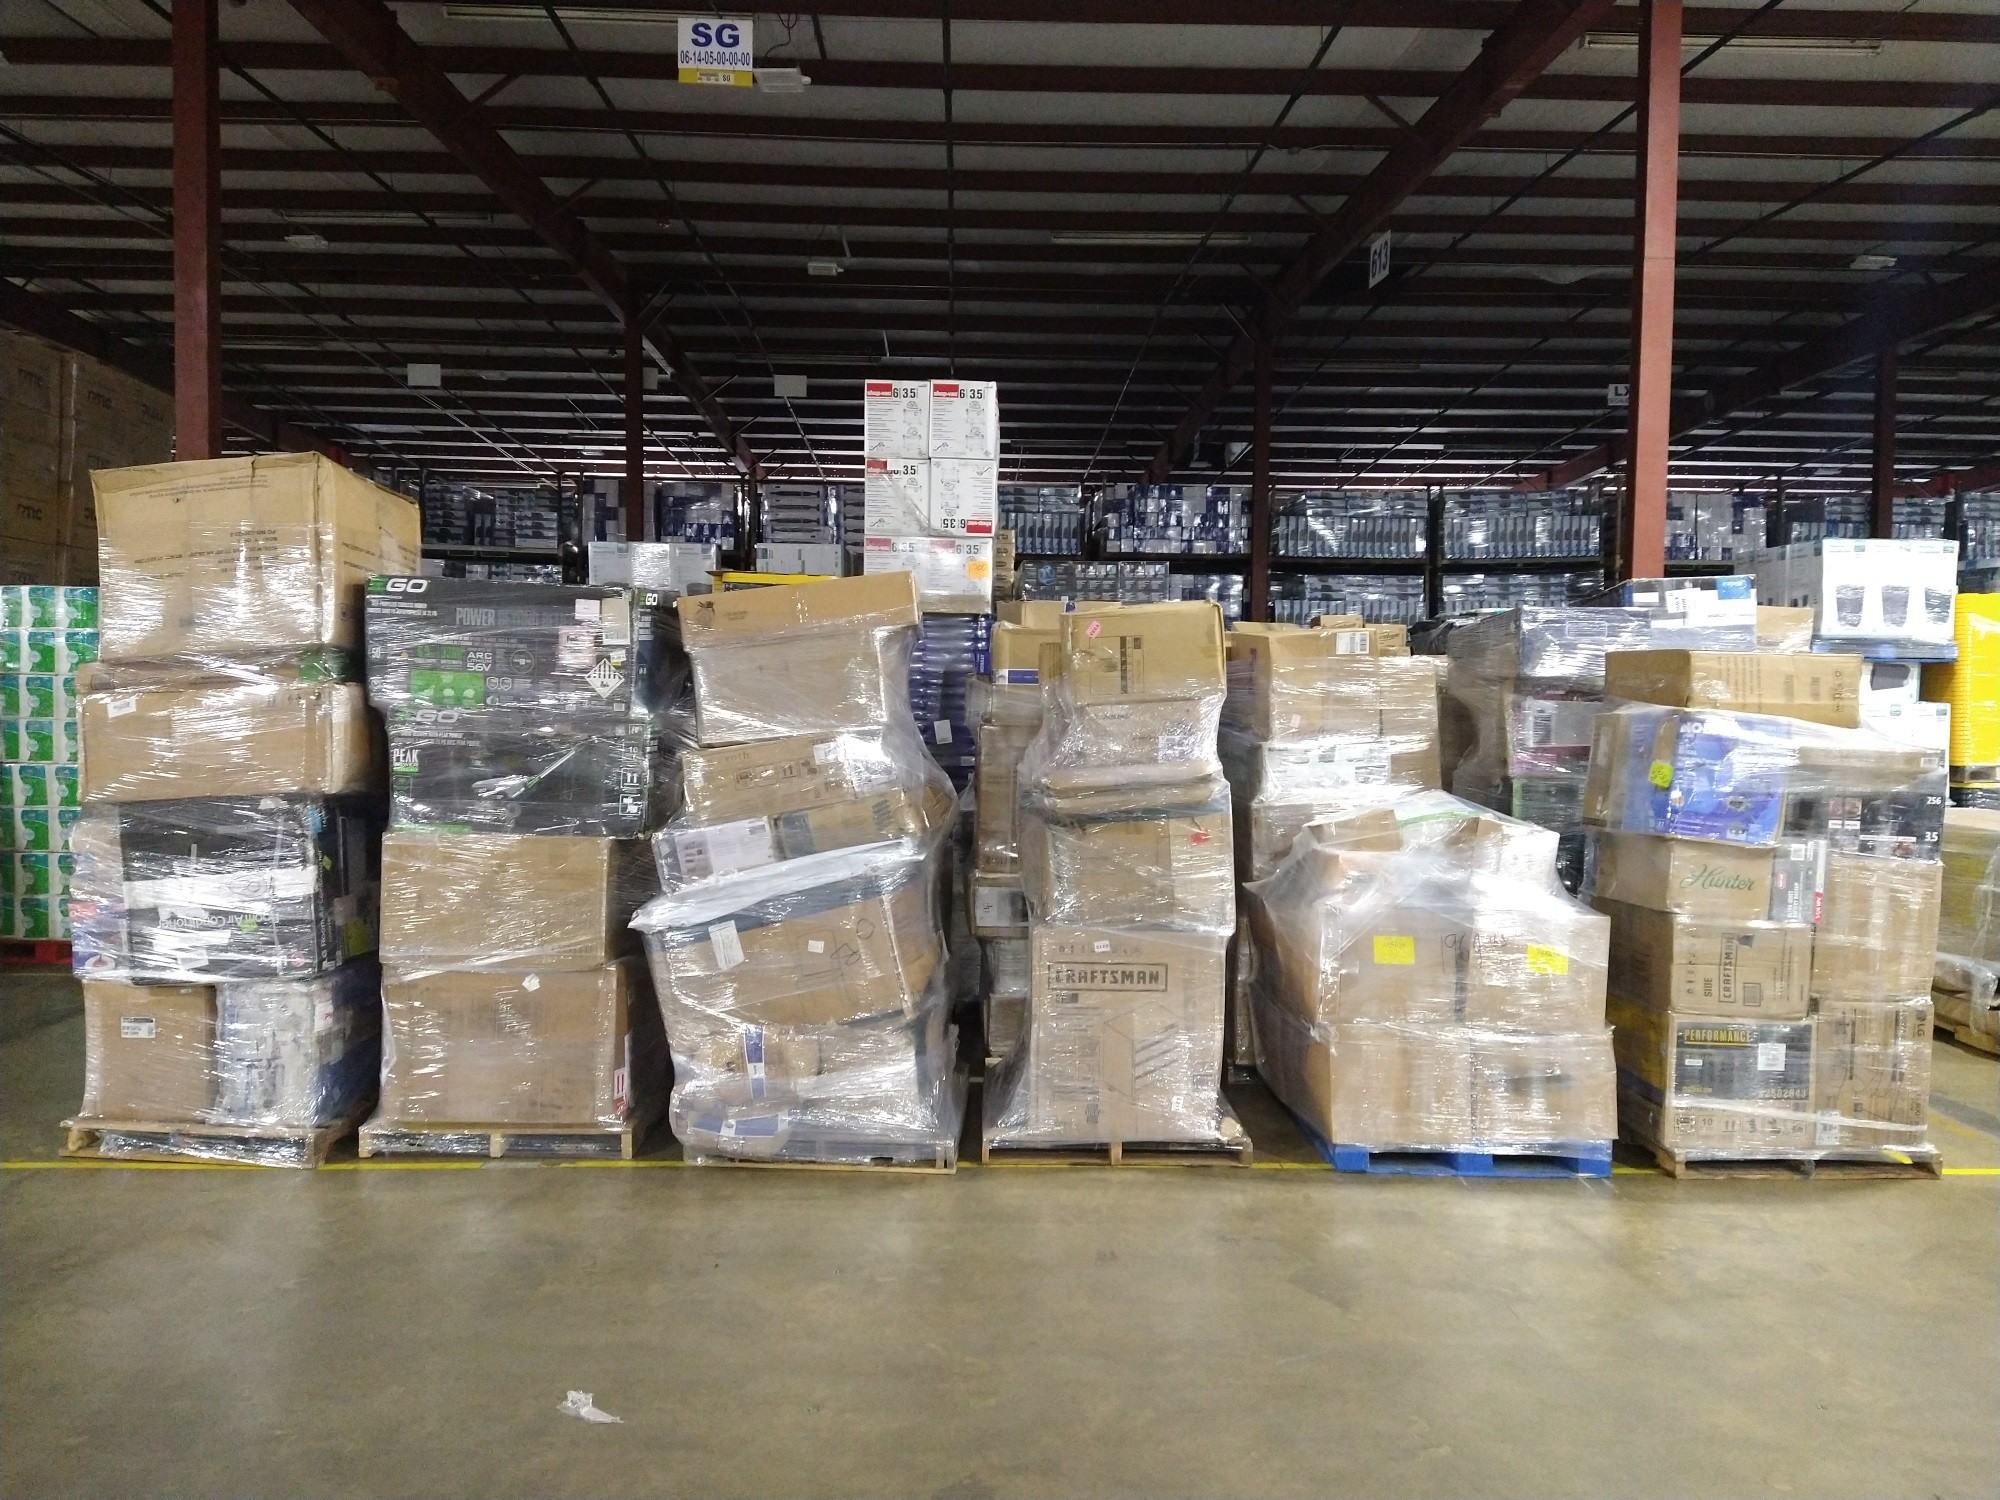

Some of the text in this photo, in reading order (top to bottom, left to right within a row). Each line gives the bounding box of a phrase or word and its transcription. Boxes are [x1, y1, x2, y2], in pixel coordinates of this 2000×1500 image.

[691, 22, 740, 48] SG
[680, 50, 751, 66] 06-14-05-00-00-00
[893, 388, 899, 398] 6
[960, 388, 966, 398] 6
[456, 607, 495, 626] POWER
[467, 651, 493, 660] ARC
[466, 663, 491, 671] 56V
[393, 749, 419, 762] PEAK
[1926, 796, 1943, 805] 256
[1679, 863, 1755, 891] Hunter
[1723, 937, 1734, 999] CRAFTSMAN
[1055, 969, 1160, 985] CRAFTSMAN
[1703, 977, 1713, 998] SIDE
[1917, 1023, 1925, 1037] LG
